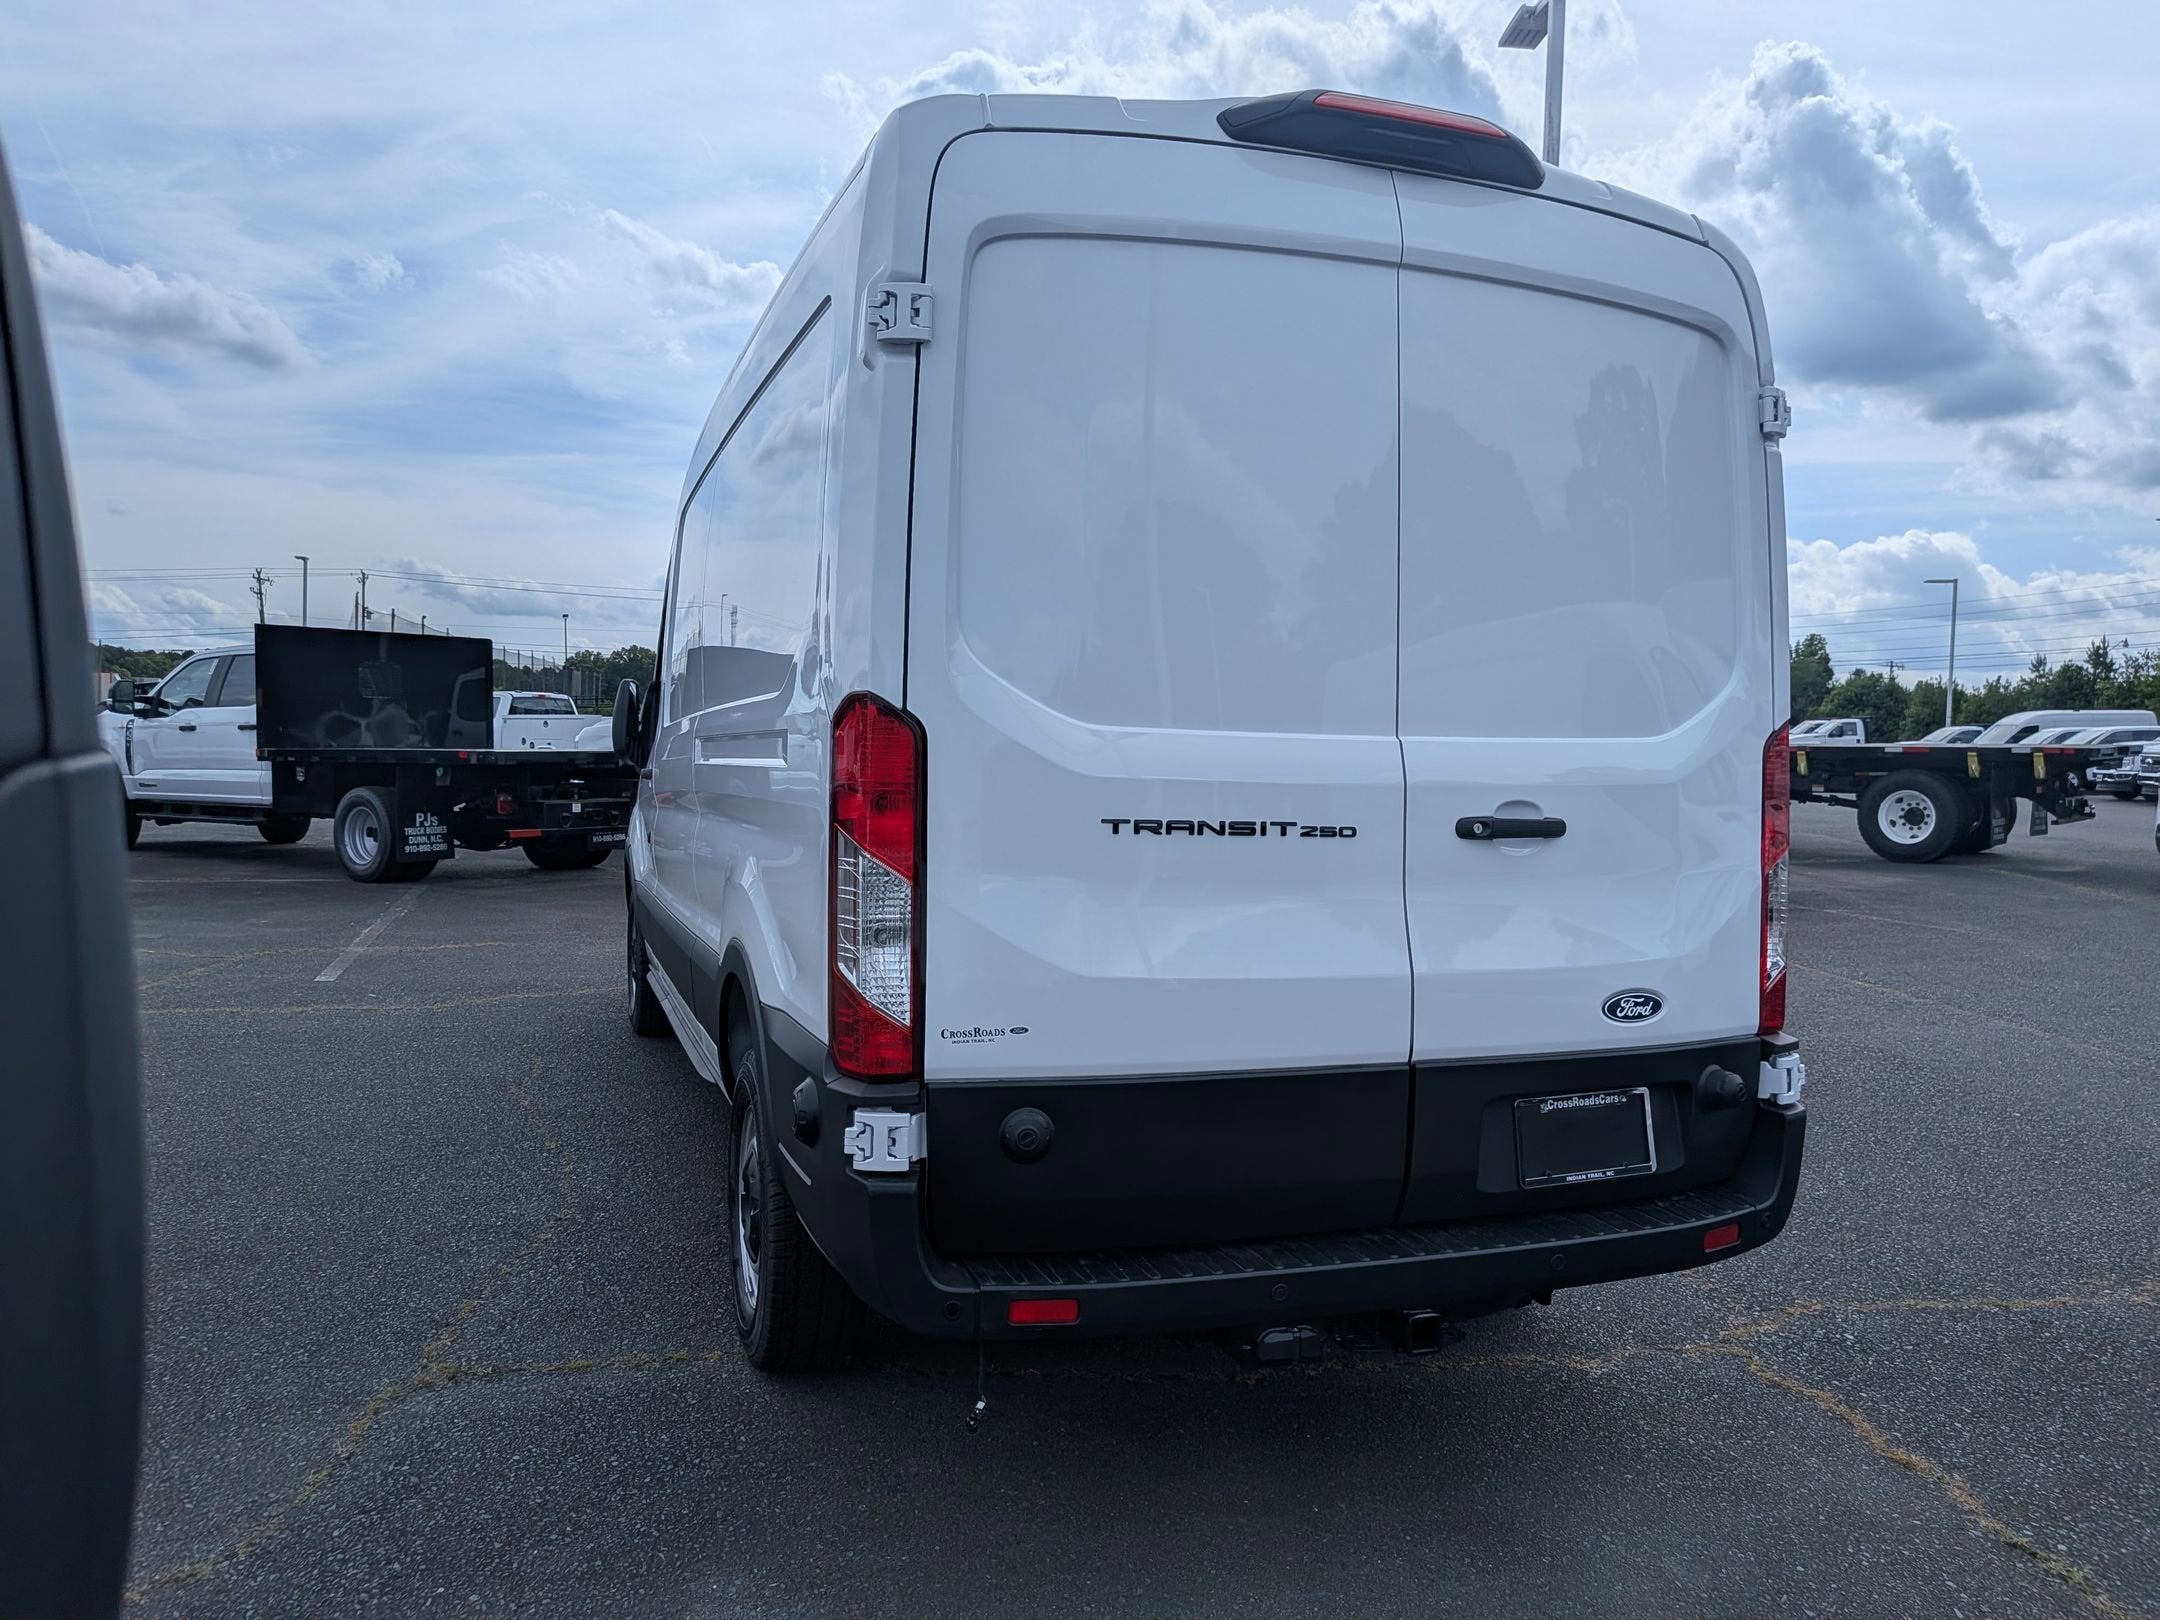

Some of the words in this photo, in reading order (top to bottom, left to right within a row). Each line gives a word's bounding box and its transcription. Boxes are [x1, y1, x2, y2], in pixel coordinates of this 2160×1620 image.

[416, 812, 438, 826] PJs
[404, 827, 425, 835] TRUCK
[426, 826, 447, 834] BODIES
[1101, 819, 1298, 837] TRANSIT
[1299, 826, 1357, 838] 250
[1617, 998, 1653, 1017] Ford
[1547, 1095, 1619, 1110] CrossRoadsCars
[1566, 1174, 1586, 1182] INDIAN
